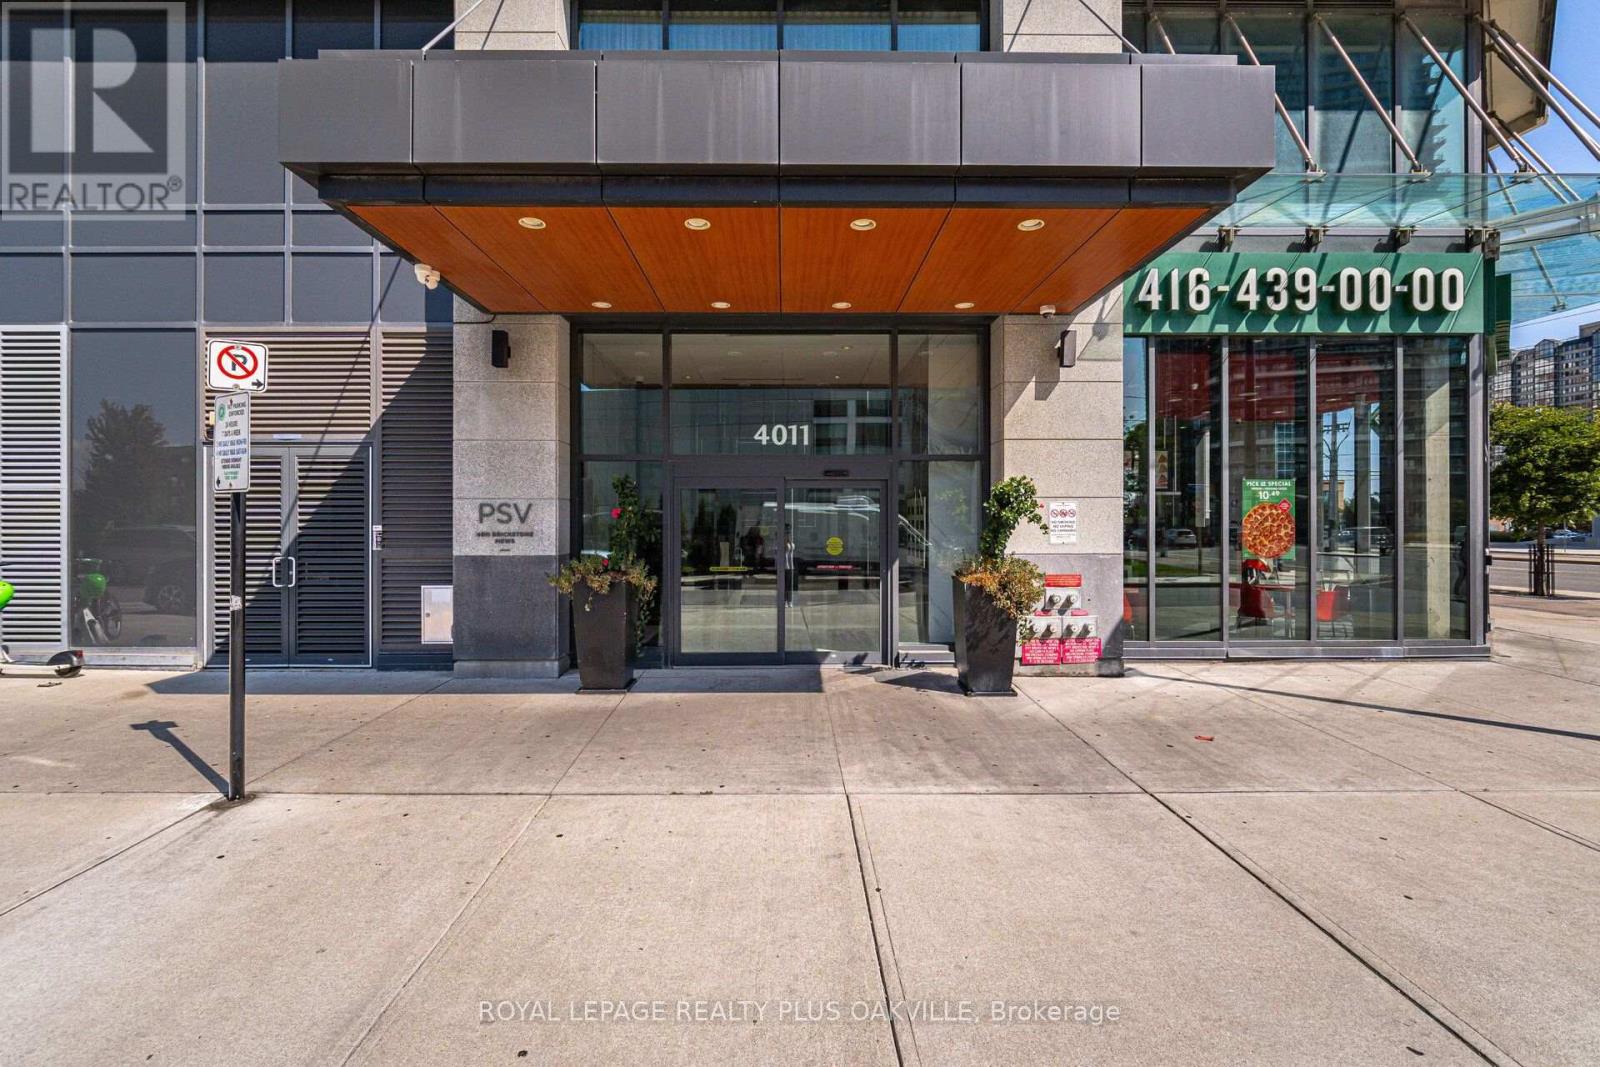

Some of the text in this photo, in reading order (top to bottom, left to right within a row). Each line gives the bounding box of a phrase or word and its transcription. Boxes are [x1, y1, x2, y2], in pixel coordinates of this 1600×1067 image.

[1138, 267, 1464, 311] 416-439-00-00
[753, 424, 809, 446] 4011
[479, 502, 533, 524] PSV
